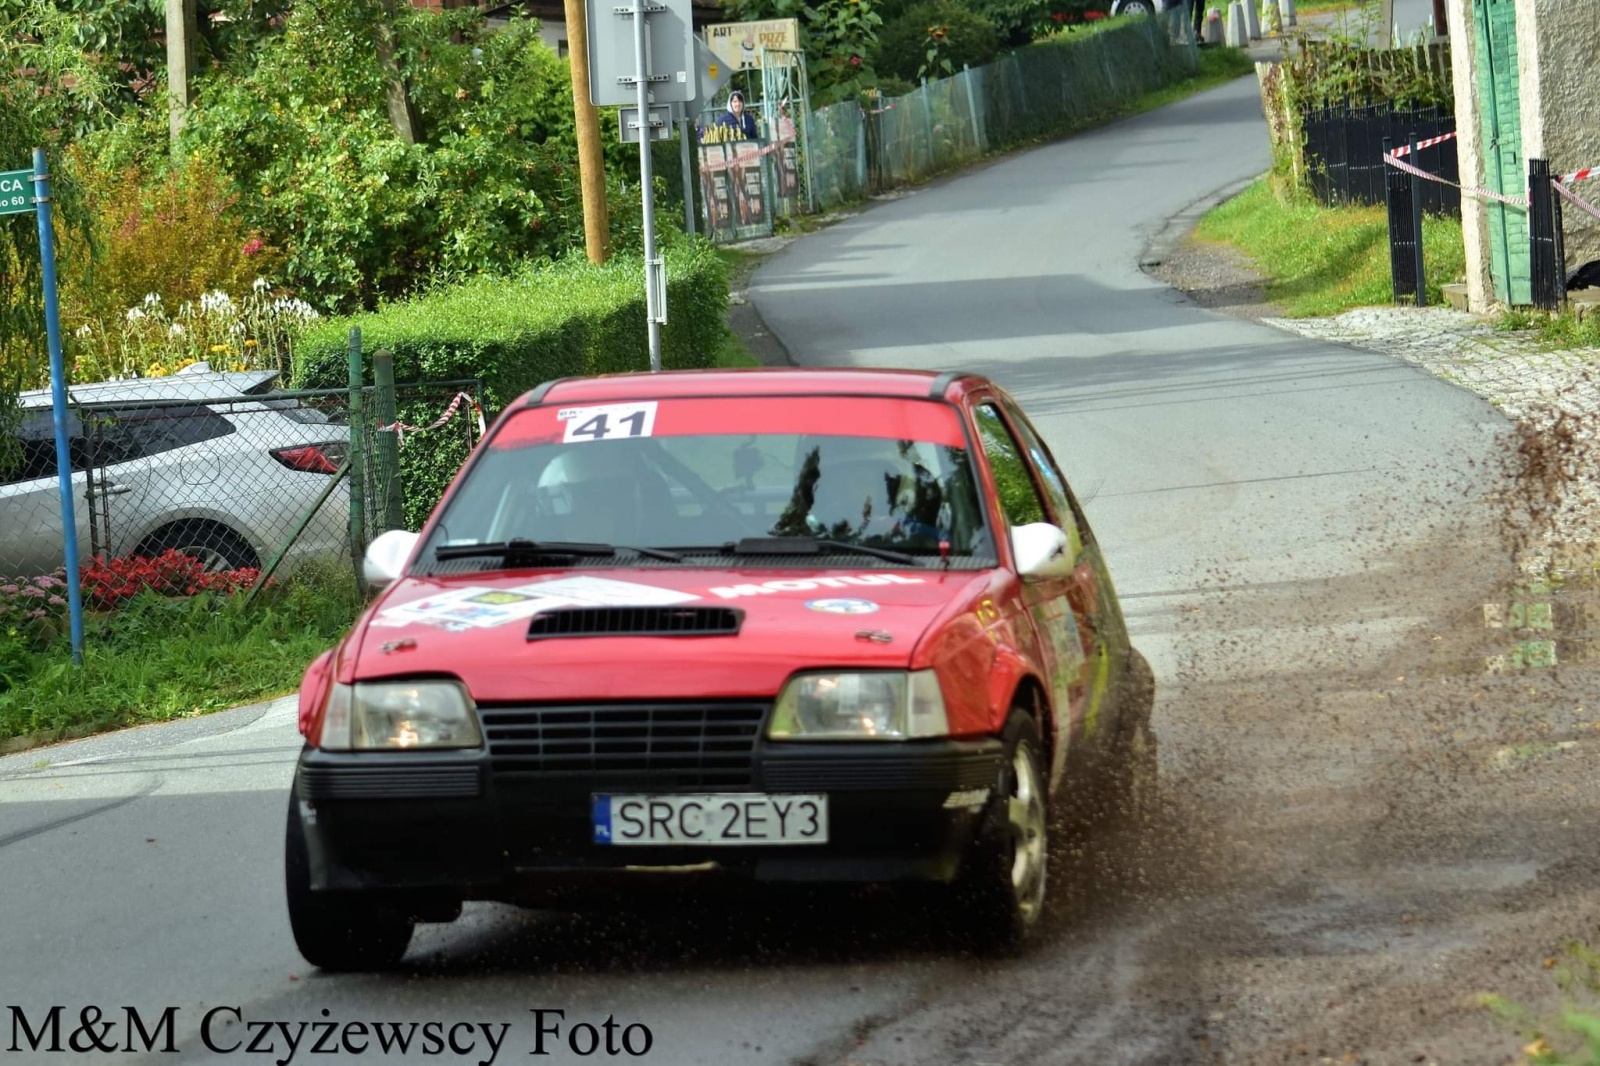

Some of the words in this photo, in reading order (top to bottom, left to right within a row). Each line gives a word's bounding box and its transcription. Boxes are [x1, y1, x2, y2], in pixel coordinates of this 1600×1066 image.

[11, 196, 25, 206] 60
[571, 410, 647, 439] 41
[708, 573, 926, 599] MOTUL
[619, 801, 704, 839] SRC
[720, 801, 819, 838] 2EY3
